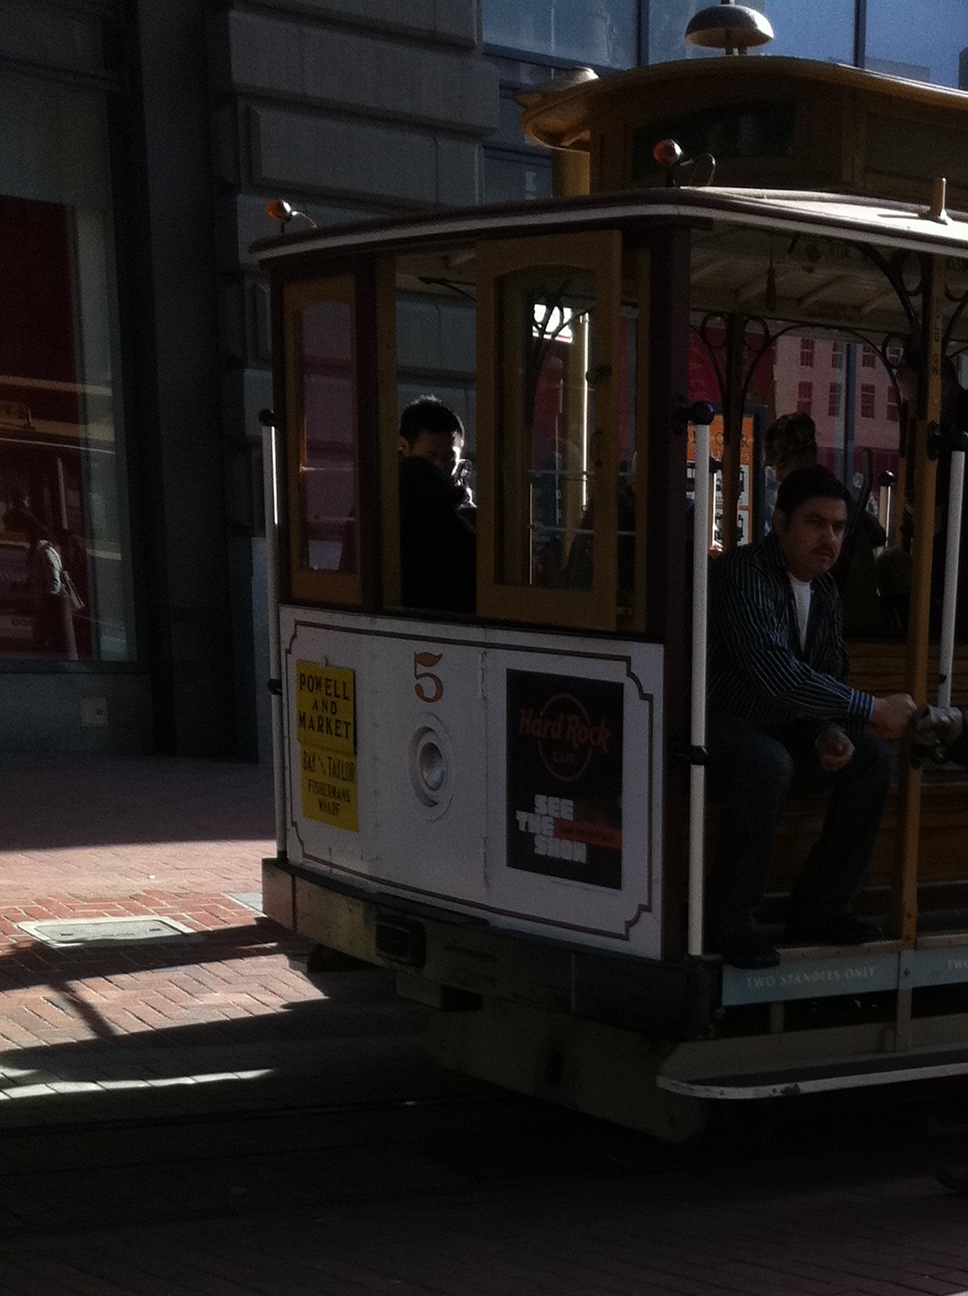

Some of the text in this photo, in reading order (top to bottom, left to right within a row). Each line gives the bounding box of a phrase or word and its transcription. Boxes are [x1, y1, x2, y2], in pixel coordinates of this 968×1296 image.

[300, 673, 350, 700] POWELL
[413, 651, 443, 702] 5
[312, 700, 337, 715] AND
[298, 711, 350, 739] MARKET
[518, 706, 611, 754] Hard Rock
[534, 793, 574, 821] SEE
[516, 809, 555, 837] THE
[746, 966, 875, 988] TWO STANDEES ONLY
